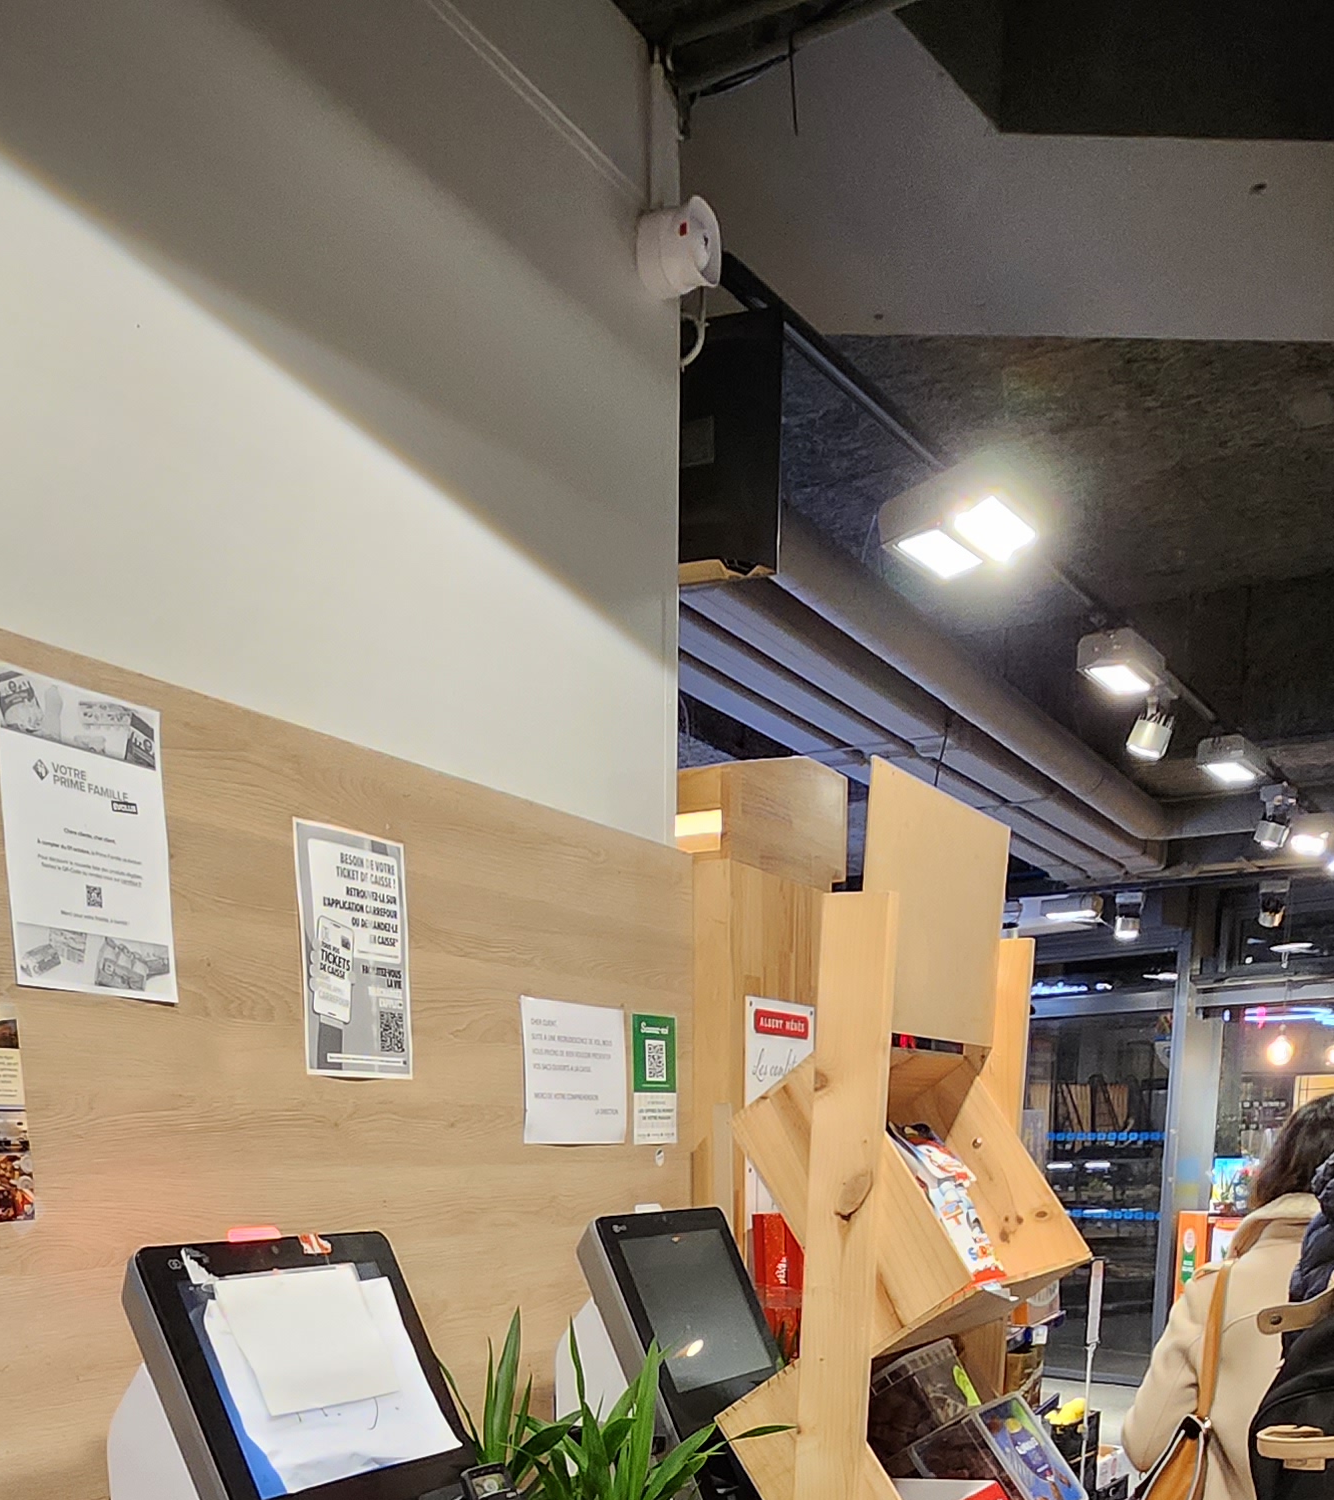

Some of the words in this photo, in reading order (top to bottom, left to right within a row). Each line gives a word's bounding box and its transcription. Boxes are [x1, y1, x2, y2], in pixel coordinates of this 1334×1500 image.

[52, 762, 86, 781] VOTRE
[53, 775, 86, 792] PRIME
[88, 783, 128, 802] FAMILLE
[336, 866, 358, 880] TICKET
[375, 861, 395, 876] VOTRE
[321, 949, 350, 971] TICKETS
[320, 962, 327, 972] DE
[328, 965, 345, 979] CAISSE
[760, 1016, 783, 1029] ALBERT
